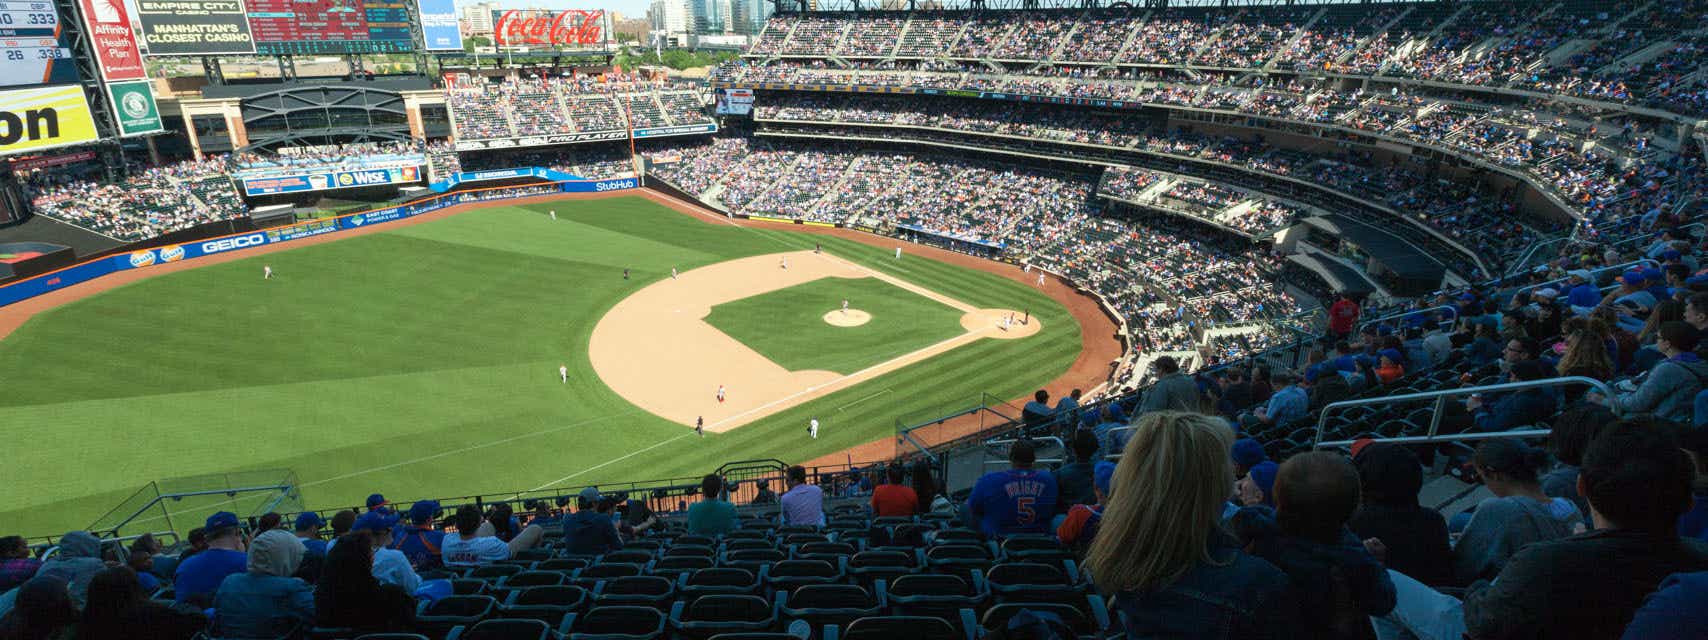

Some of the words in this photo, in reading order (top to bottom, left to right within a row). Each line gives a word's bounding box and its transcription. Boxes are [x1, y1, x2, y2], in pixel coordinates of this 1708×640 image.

[143, 2, 200, 10] EMPIRE
[204, 2, 236, 10] CITY
[95, 24, 130, 36] Affinity
[153, 23, 239, 34] MANHATTAN'S
[101, 38, 131, 48] Health
[147, 33, 202, 43] CLOSEST
[204, 33, 250, 42] CASINO
[6, 50, 24, 60] 26
[109, 48, 129, 59] Plan
[549, 134, 575, 143] PRO
[576, 131, 626, 142] PLAYER
[596, 180, 634, 192] StubHub
[202, 233, 265, 254] GEICO
[1017, 496, 1037, 524] 5
